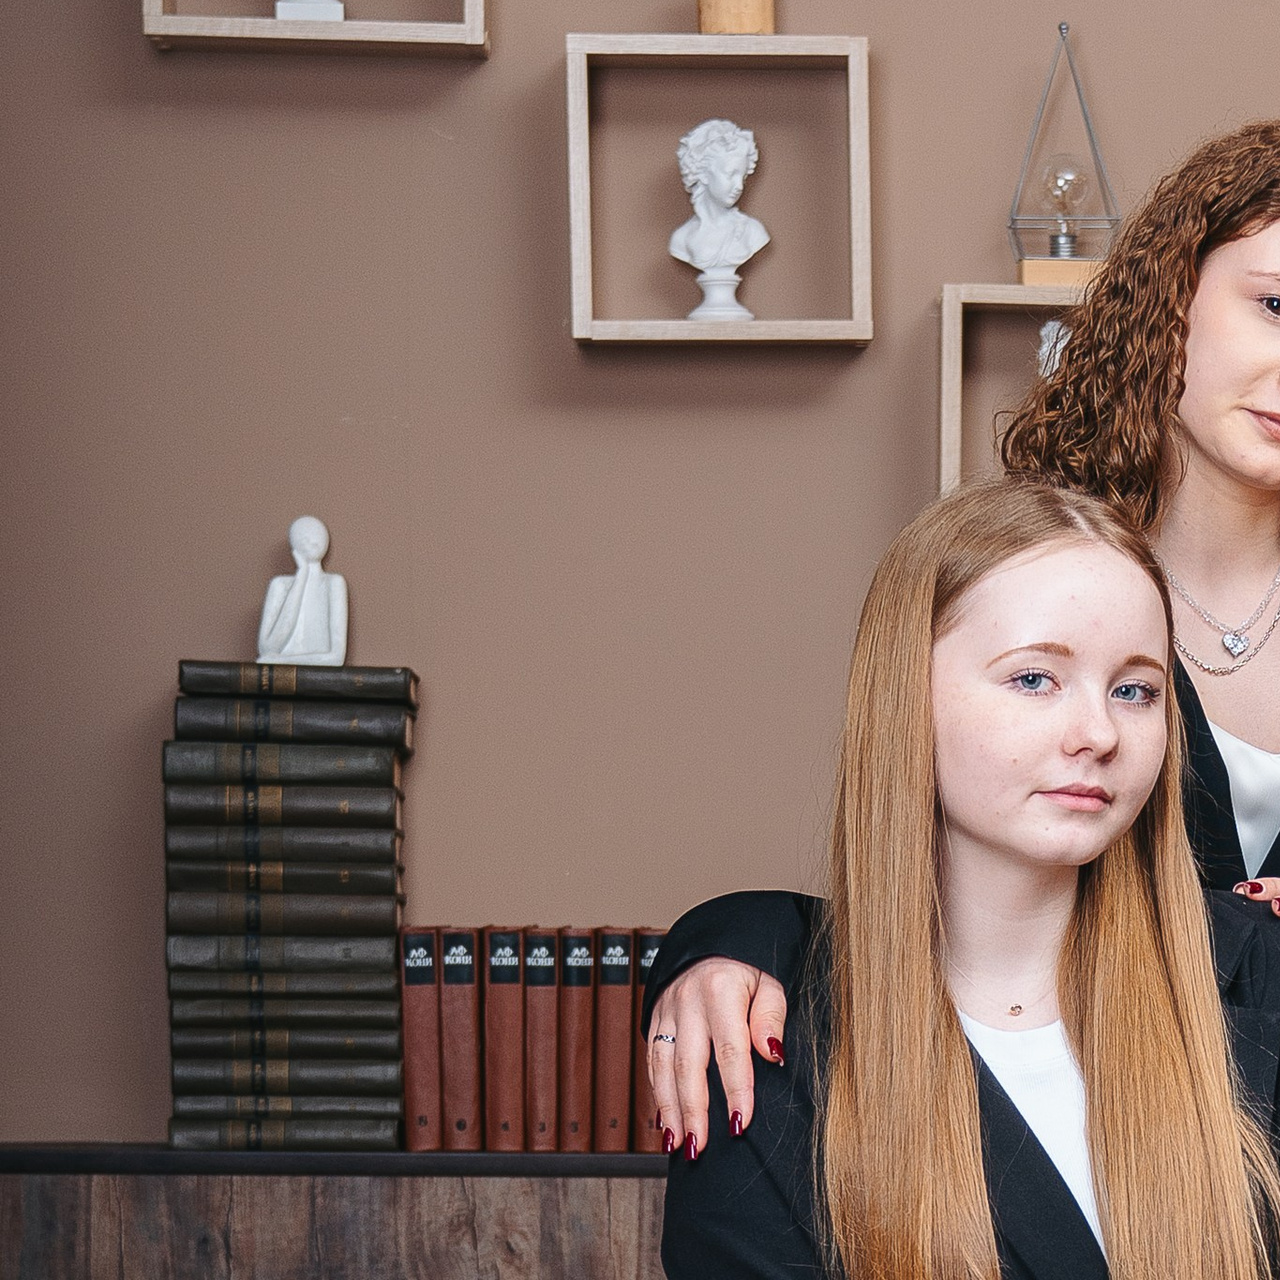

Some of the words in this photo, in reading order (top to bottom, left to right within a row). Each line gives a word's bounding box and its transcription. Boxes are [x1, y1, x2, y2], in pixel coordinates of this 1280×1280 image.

[405, 957, 432, 967] КОНИ
[444, 955, 472, 965] КОНИ
[491, 956, 518, 966] КОНИ
[527, 957, 554, 966] КОНИ
[567, 957, 593, 966] КОНИ
[602, 956, 629, 966] КОНИ
